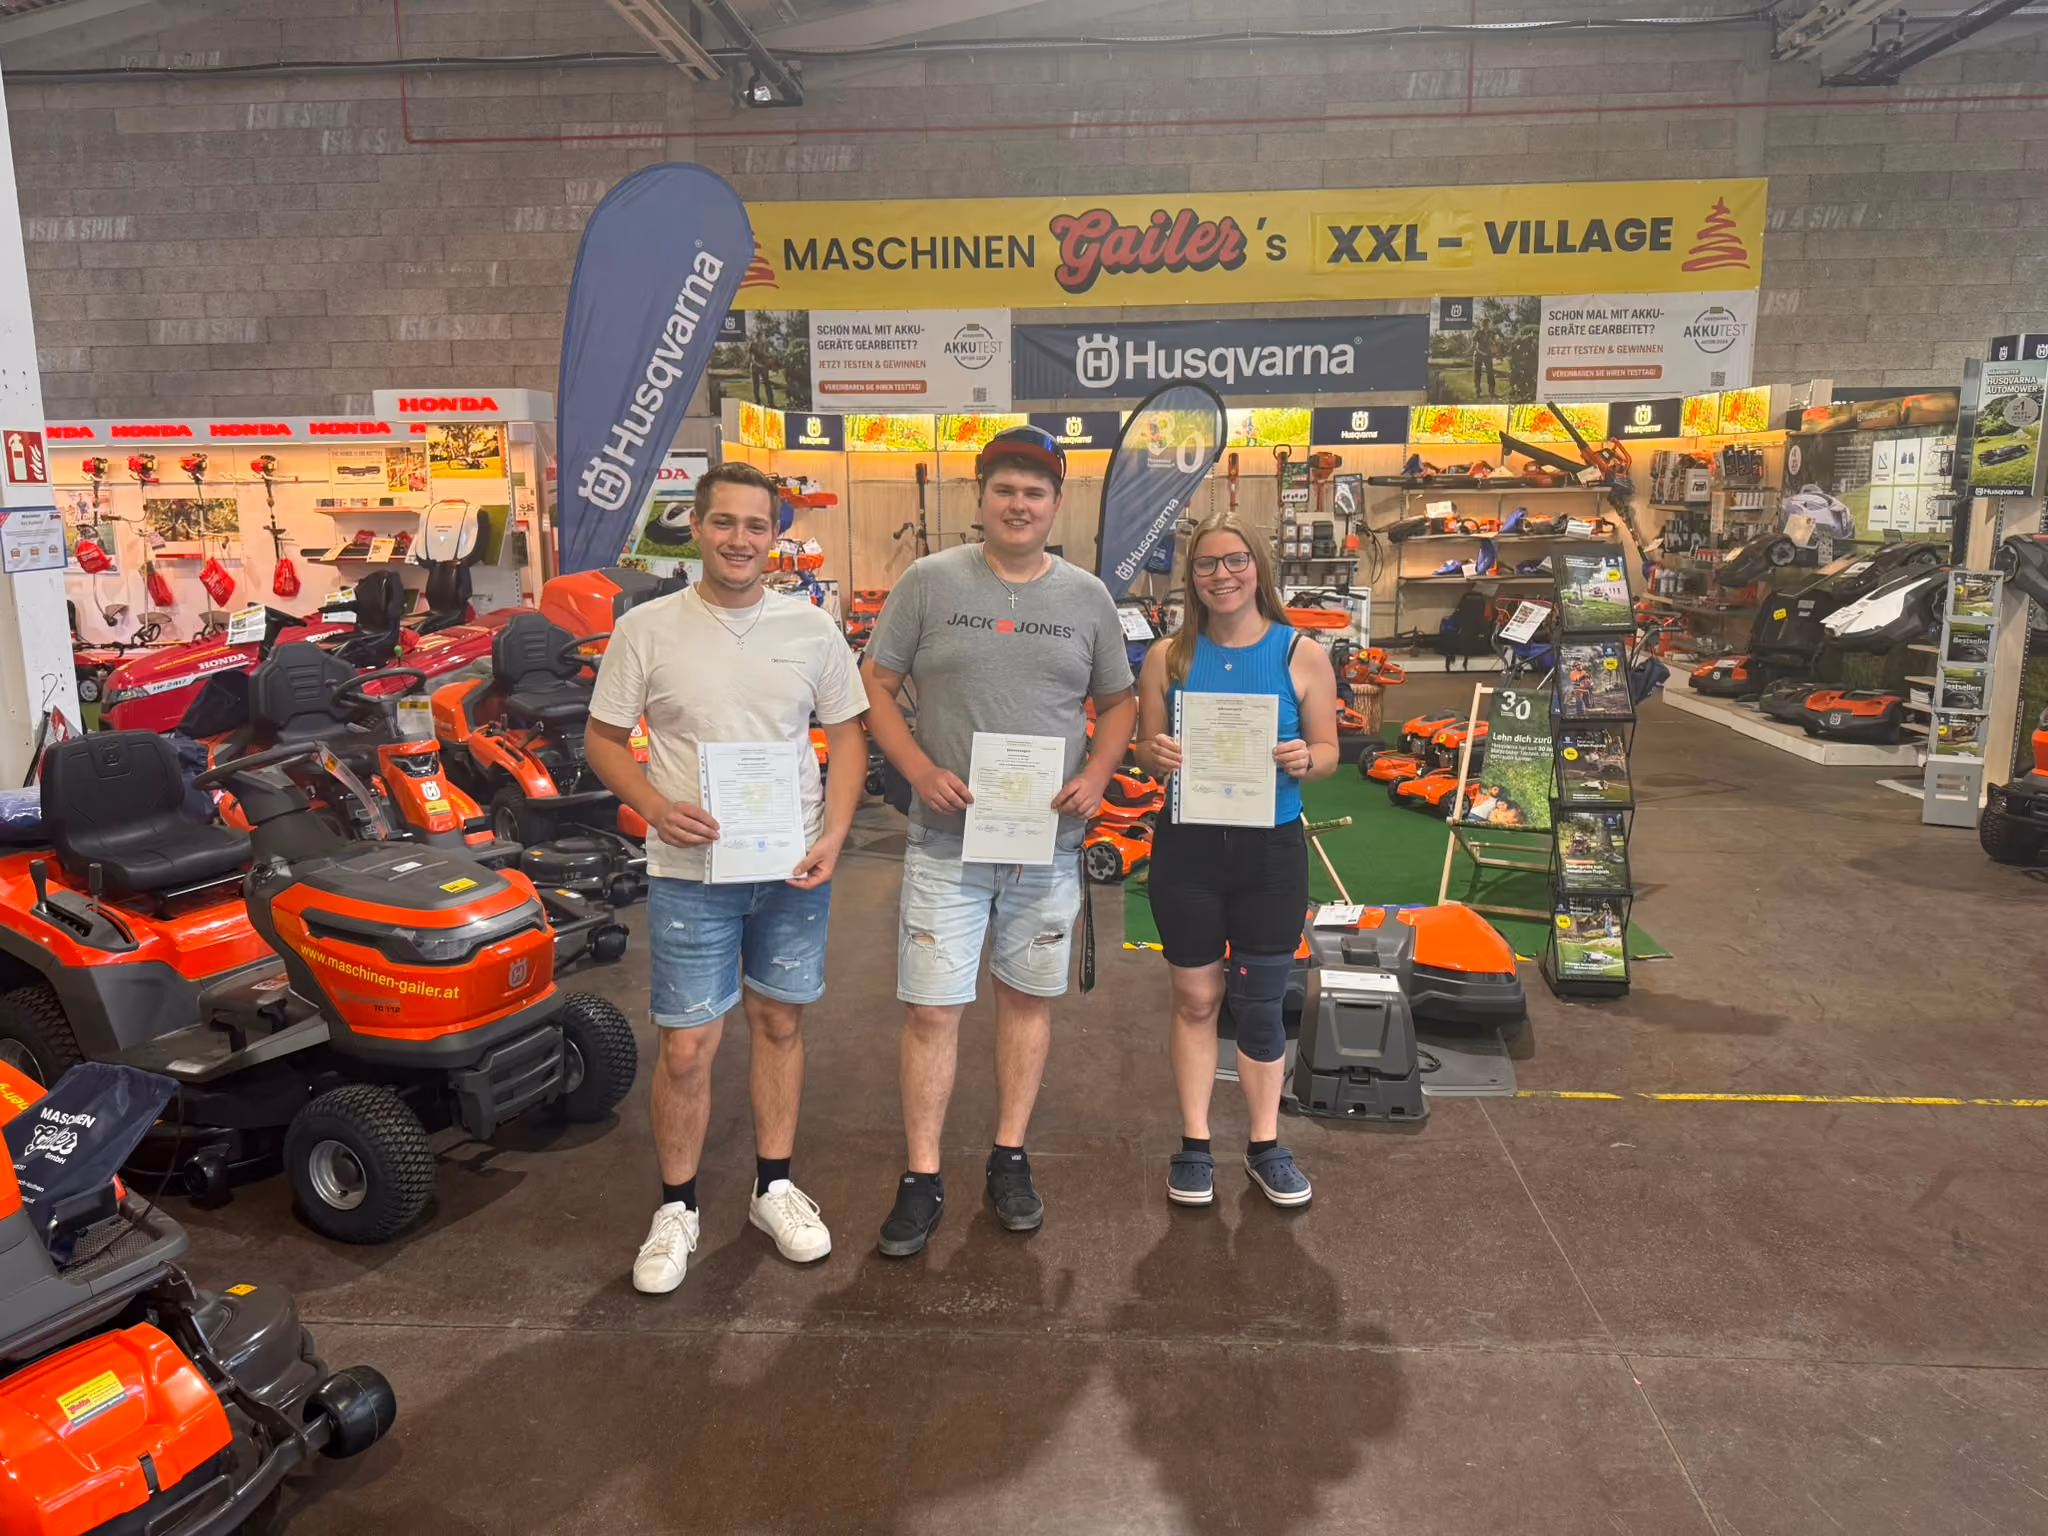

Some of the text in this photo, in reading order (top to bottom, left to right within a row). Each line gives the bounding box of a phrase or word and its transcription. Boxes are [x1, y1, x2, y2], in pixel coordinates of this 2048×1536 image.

[784, 235, 1035, 271] MASCHINEN
[1049, 208, 1247, 294] Gailer
[1326, 223, 1428, 264] XXL
[1484, 216, 1675, 254] VILLAGE
[1548, 307, 1665, 321] SCHON MAL MIT AKKU-
[817, 324, 926, 335] SCHON MAL MIT AKKU-
[1547, 323, 1656, 336] GERÄTE GEARBEITET?
[1683, 323, 1748, 338] AKKUTEST
[817, 338, 918, 351] GERÄTE GEARBEITET?
[944, 341, 1003, 355] AKKUTEST
[1547, 344, 1664, 356] JETZT TESTEN & GEWINNEN
[603, 251, 724, 467] Husqvarna
[818, 360, 926, 369] JETZT TESTEN & GEWINNEN
[1125, 340, 1355, 385] Husqvarna
[1987, 376, 2037, 386] HUSQVARNA
[1986, 385, 2038, 395] AUTOMOWER
[398, 397, 499, 412] HONDA
[46, 426, 95, 439] NDA
[111, 424, 193, 438] HONDA
[210, 423, 293, 437] HONDA
[309, 422, 391, 435] HONDA
[1341, 430, 1379, 440] Husqvarna
[1624, 423, 1662, 435] Husqvarna
[1984, 488, 2025, 498] Husqvarna
[1126, 497, 1180, 567] Husqvarna
[947, 613, 1073, 639] JACK JONES
[1953, 636, 1989, 645] Bestseller
[198, 653, 248, 670] HONDA
[1500, 690, 1531, 720] 30
[1492, 731, 1553, 745] Lehn dich zurü
[301, 945, 460, 999] www.maschinen-gailer.at
